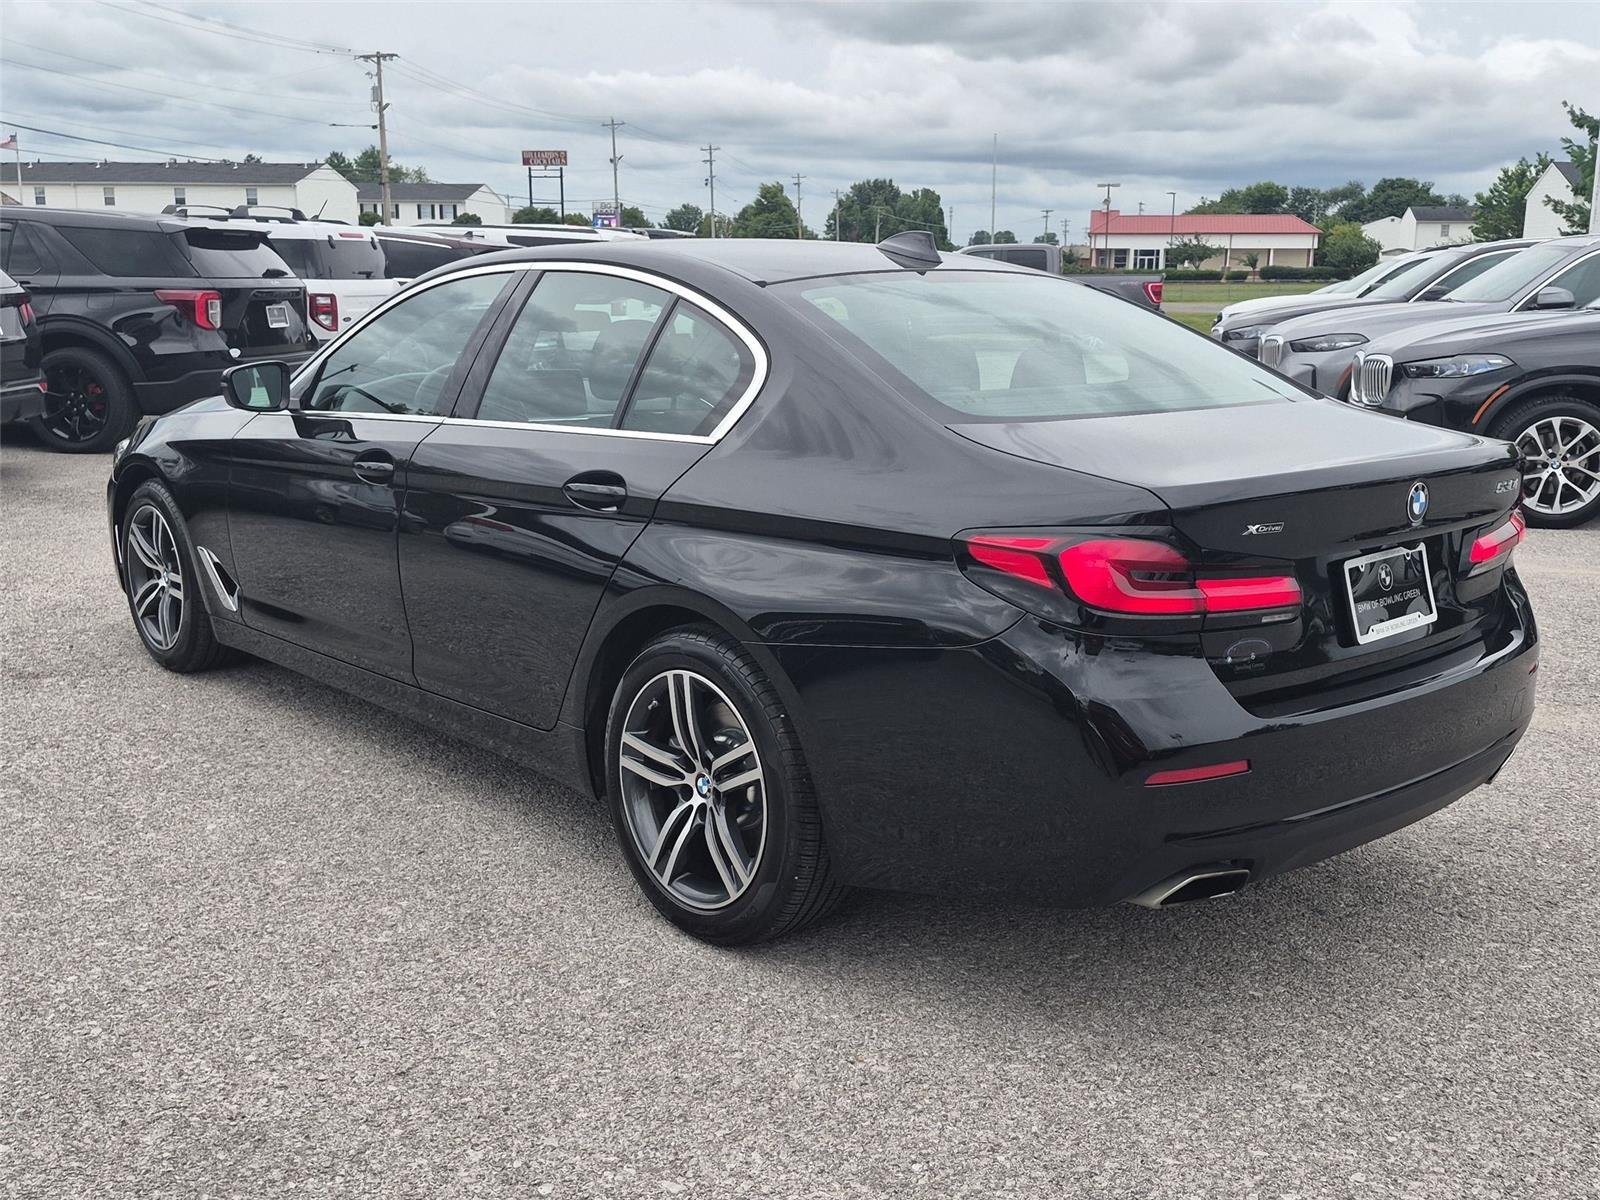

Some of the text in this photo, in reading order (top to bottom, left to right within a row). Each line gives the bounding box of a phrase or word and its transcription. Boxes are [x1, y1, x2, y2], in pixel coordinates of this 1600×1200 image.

[1358, 589, 1420, 612] BMW OF BOWLING GREEN
